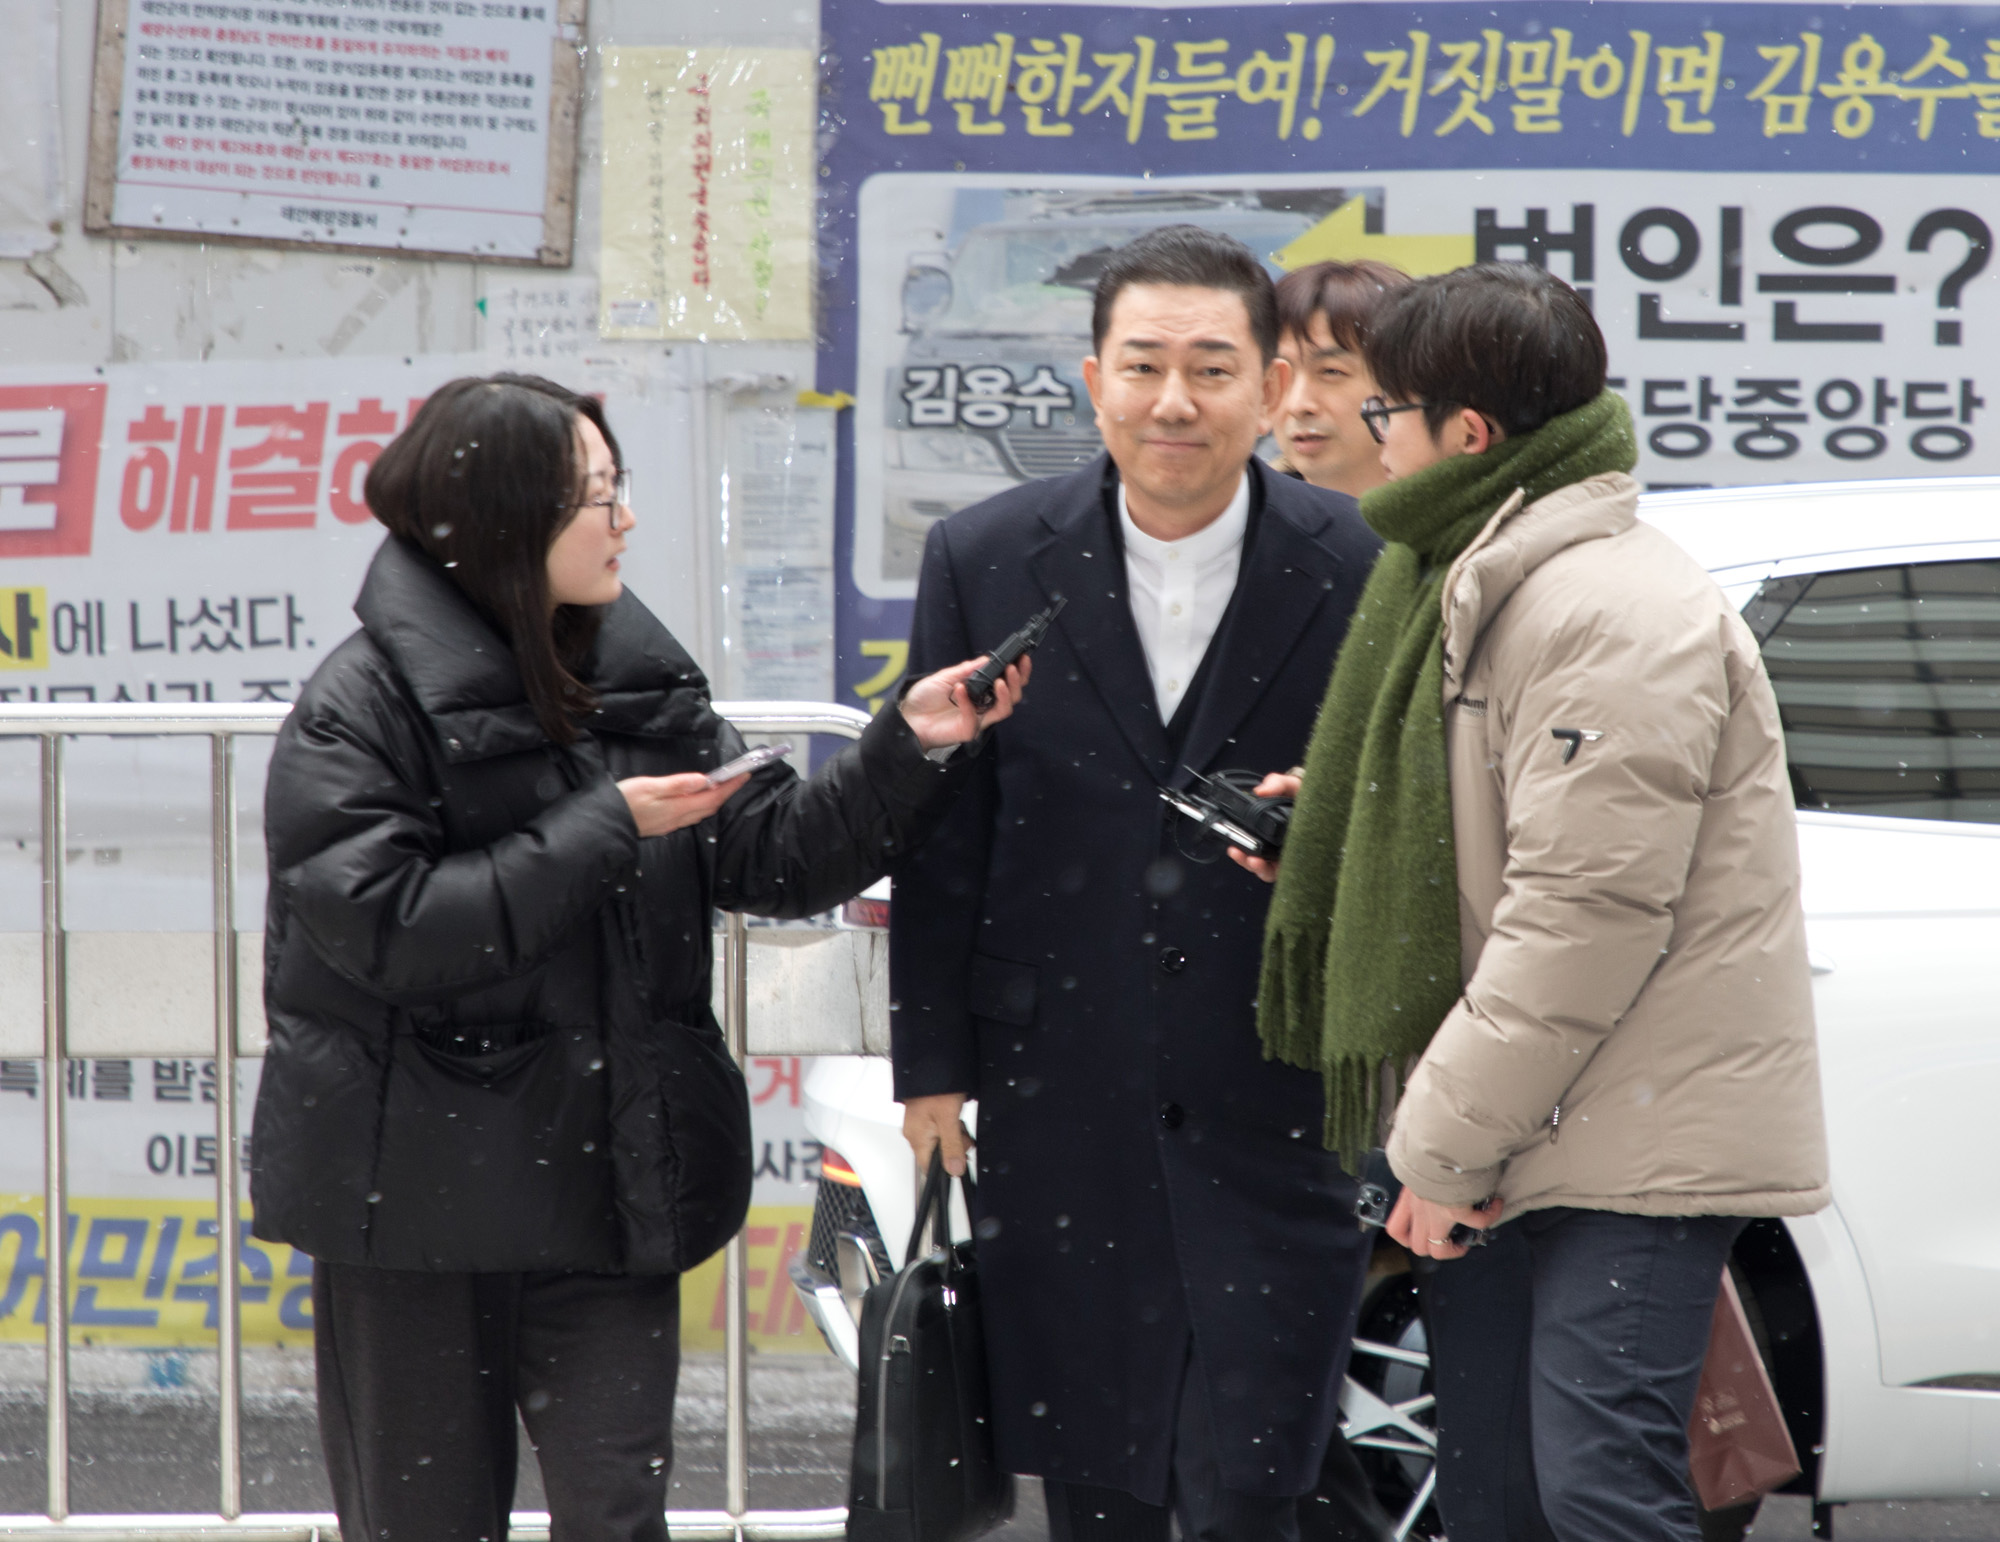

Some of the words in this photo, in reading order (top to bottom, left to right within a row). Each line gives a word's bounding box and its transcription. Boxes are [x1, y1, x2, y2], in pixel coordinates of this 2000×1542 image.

[1353, 28, 1725, 138] 거짓말이면
[904, 362, 1075, 429] 김용수
[1607, 376, 1986, 461] 당중앙당
[129, 593, 316, 654] 나섰다.
